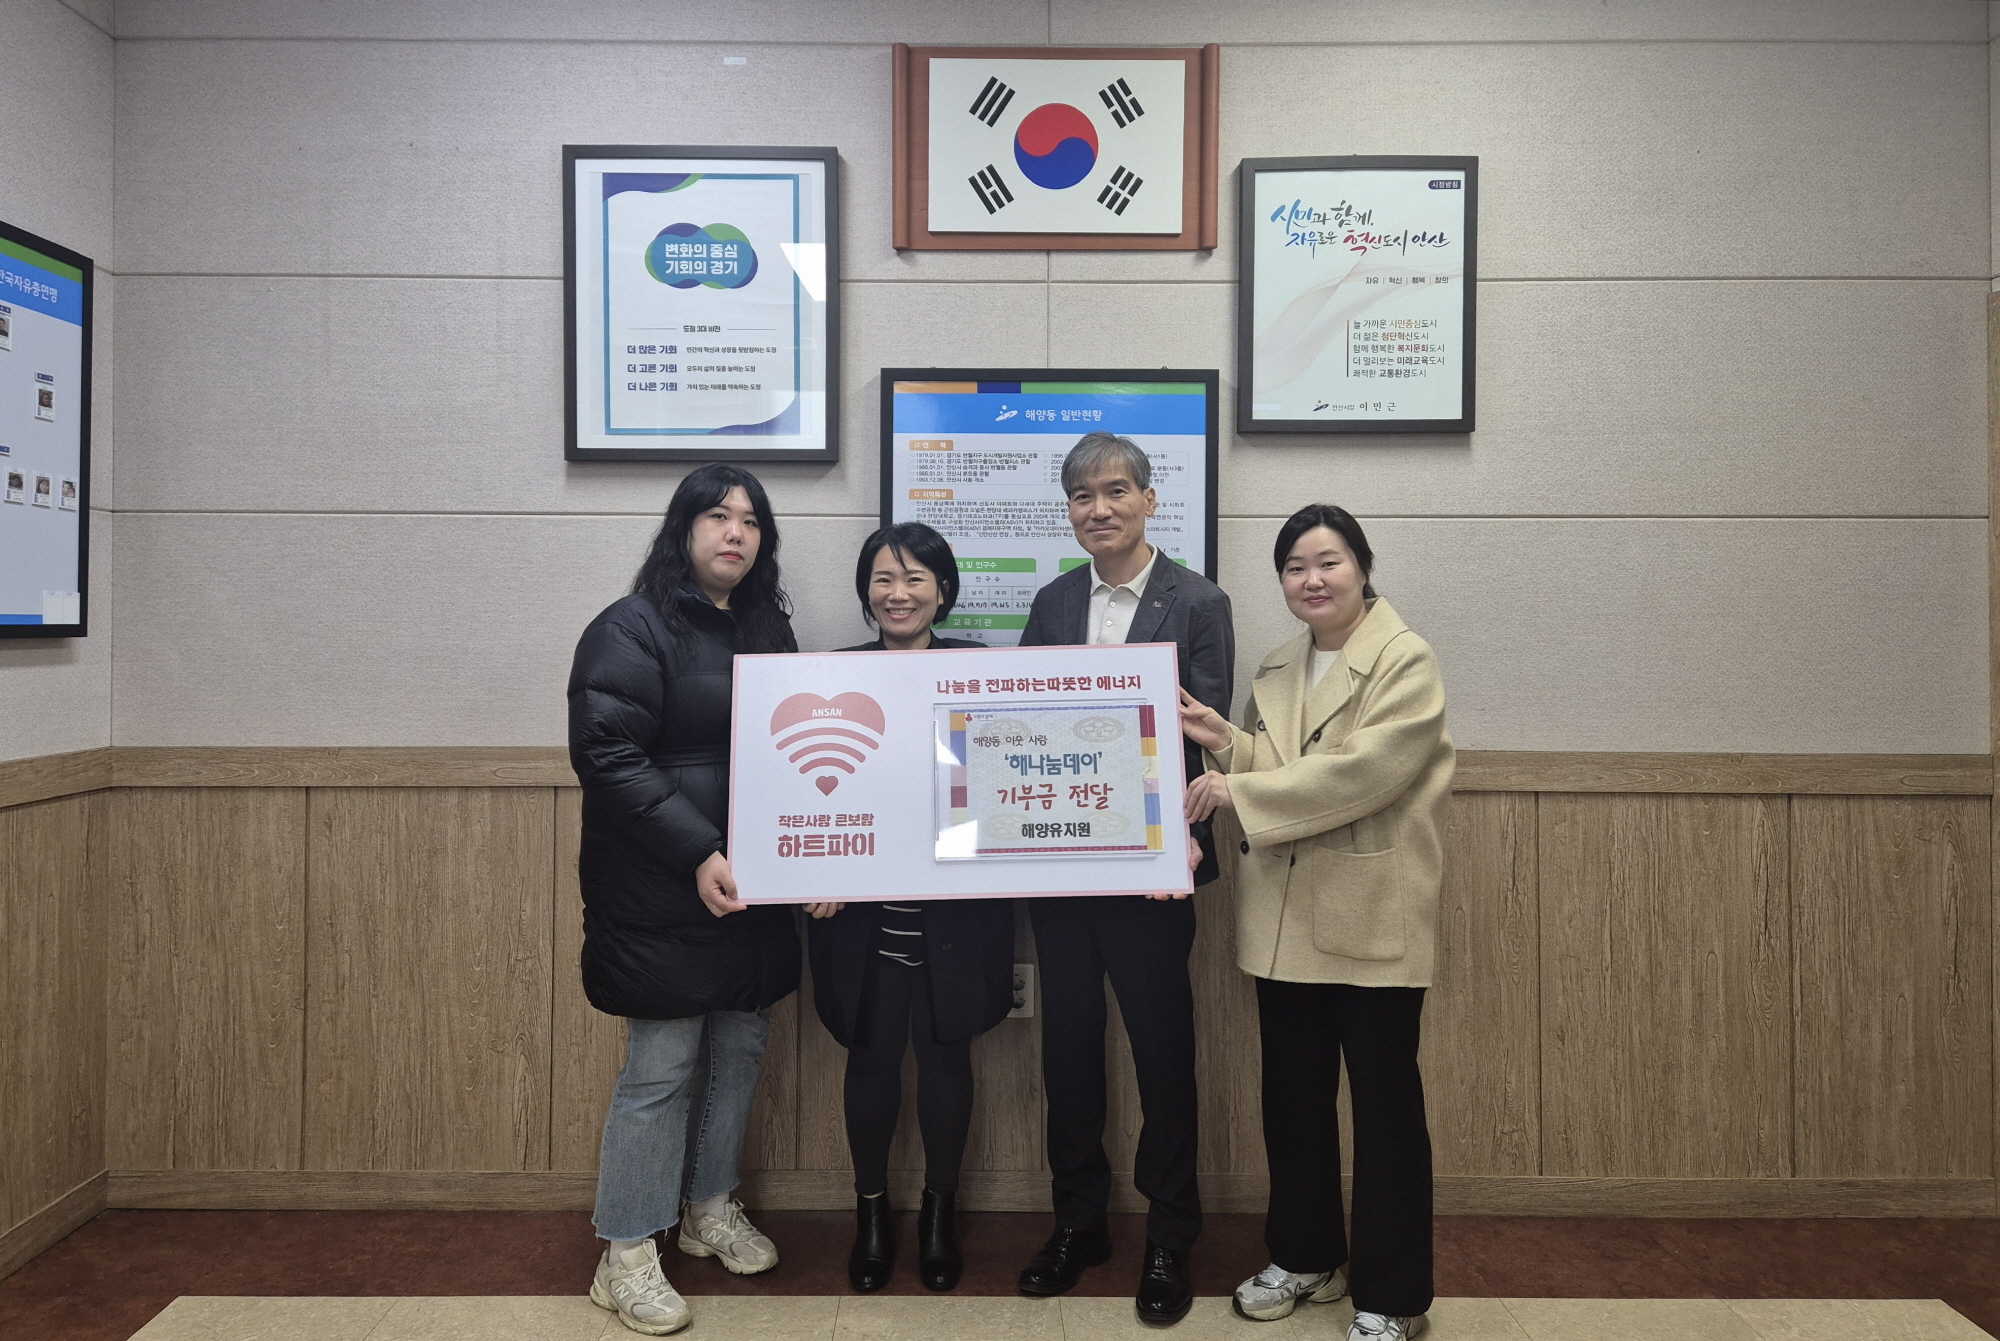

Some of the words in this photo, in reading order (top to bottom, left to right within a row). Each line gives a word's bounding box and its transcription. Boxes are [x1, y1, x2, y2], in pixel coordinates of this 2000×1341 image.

[1431, 181, 1458, 189] 시정방침
[1270, 199, 1331, 235] 시민과
[1284, 231, 1338, 259] 자유로운
[1343, 229, 1408, 256] 혁신도시
[1411, 231, 1451, 248] 안산
[665, 243, 707, 258] 변화의
[710, 243, 738, 258] 중심
[665, 260, 707, 274] 기회의
[710, 261, 738, 275] 경기
[1365, 276, 1379, 284] 자유
[1389, 276, 1402, 284] 혁신
[1412, 276, 1425, 284] 행복
[1353, 320, 1361, 329] 늘
[1363, 319, 1387, 329] 가까운
[1389, 319, 1437, 329] 시민중심도시
[1353, 333, 1361, 341] 더
[1363, 332, 1379, 341] 젊은
[1381, 332, 1429, 341] 첨단혁신도시
[627, 345, 636, 354] 더
[638, 345, 656, 354] 많은
[659, 345, 677, 354] 기회
[1353, 344, 1369, 353] 함께
[1371, 344, 1394, 353] 행복한
[1397, 344, 1445, 353] 복지문화도시
[1353, 357, 1361, 366] 더
[1363, 357, 1395, 366] 멀리보는
[1397, 356, 1445, 366] 미래교육도시
[627, 364, 636, 373] 더
[638, 364, 657, 373] 고른
[659, 364, 677, 373] 기회
[1353, 369, 1376, 378] 쾌적한
[1379, 369, 1427, 378] 교통환경도시
[628, 382, 637, 391] 더
[639, 382, 657, 391] 나은
[660, 382, 677, 391] 기회
[1025, 409, 1057, 421] 해양동
[1060, 409, 1102, 421] 일반현황
[922, 491, 947, 499] 지역특성
[975, 561, 997, 569] 인구수
[936, 679, 982, 695] 나눔을
[985, 676, 1092, 694] 전파하는따뜻한
[1096, 675, 1142, 691] 에너지
[812, 708, 842, 718] ANSAN
[973, 735, 1001, 748] 해양동
[1006, 735, 1024, 747] 이웃
[1028, 734, 1048, 746] 사랑
[997, 783, 1057, 811] 기부금
[1068, 782, 1114, 810] 전달
[779, 814, 832, 828] 작은사랑
[835, 813, 875, 827] 큰보람
[778, 832, 875, 858] 하트파이
